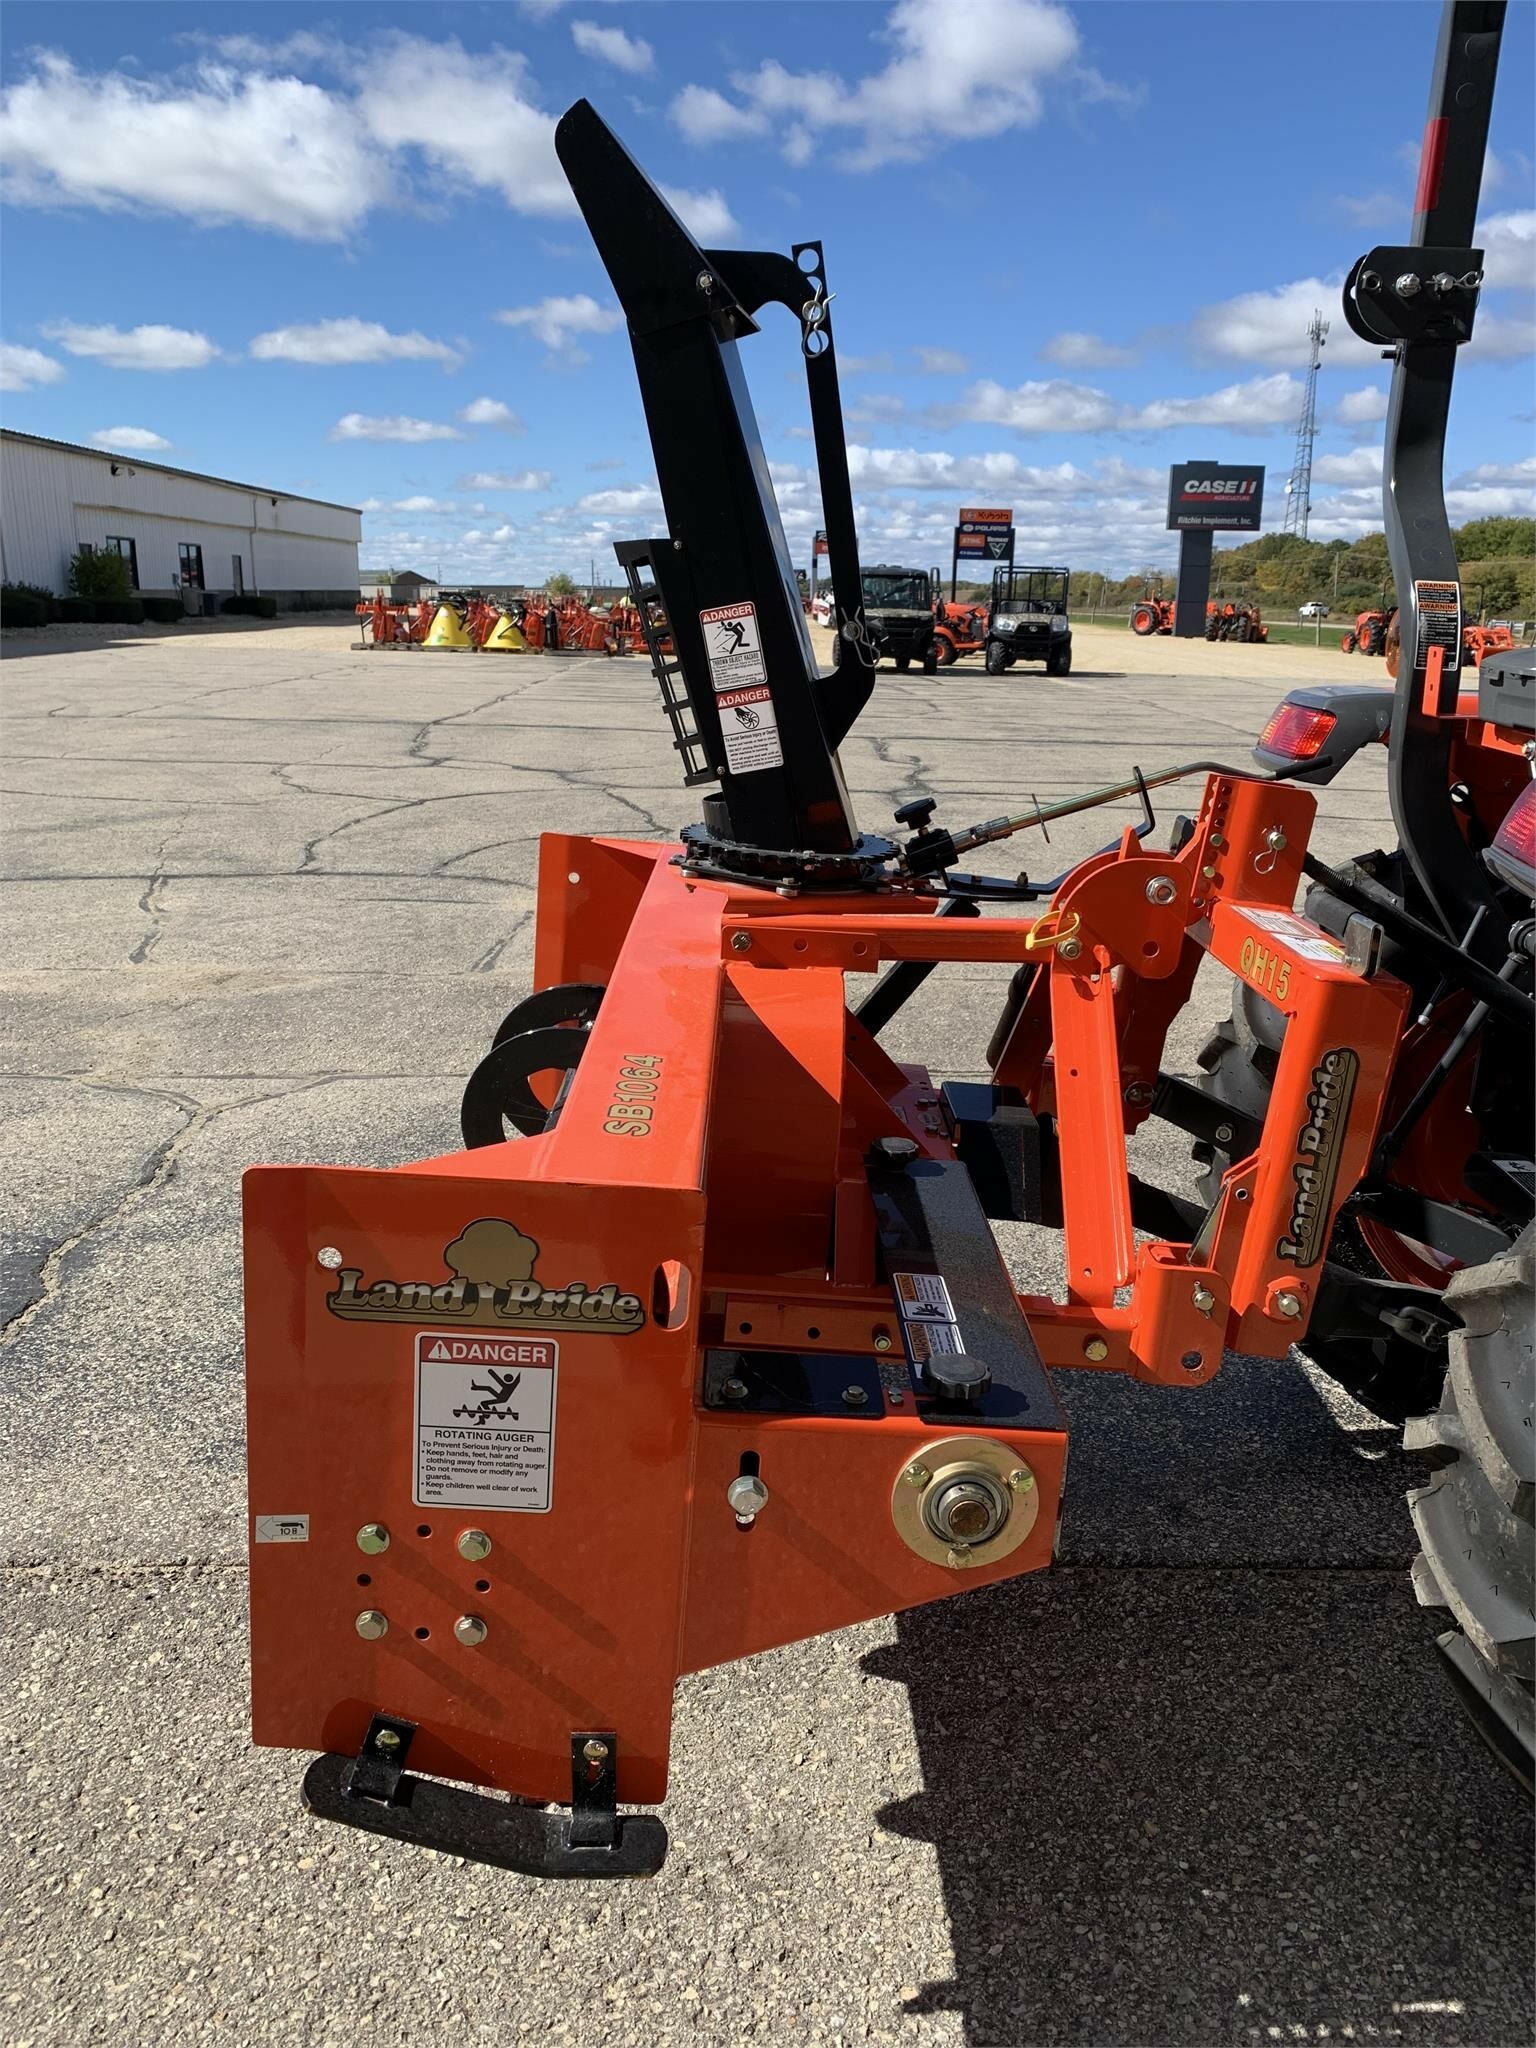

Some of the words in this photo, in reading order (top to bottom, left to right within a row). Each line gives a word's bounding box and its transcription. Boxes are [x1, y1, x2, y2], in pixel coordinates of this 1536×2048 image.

[1184, 480, 1238, 494] CASE
[978, 511, 1009, 520] Kubota
[1240, 517, 1254, 525] Inc.
[711, 605, 753, 621] DANGER
[727, 689, 771, 705] DANGER
[1241, 936, 1292, 1001] QH15
[603, 1055, 663, 1136] SB1064
[1299, 1053, 1347, 1157] Pride
[1278, 1163, 1325, 1262] Land
[334, 1269, 468, 1312] Land
[500, 1279, 644, 1322] Pride
[452, 1342, 547, 1363] DANGER
[435, 1430, 491, 1441] ROTATING
[495, 1433, 534, 1443] AUGER
[433, 1441, 460, 1449] Prevent
[462, 1442, 489, 1450] Serious
[491, 1444, 512, 1452] Injury
[426, 1449, 445, 1457] Keep
[446, 1450, 470, 1458] hands,
[472, 1451, 487, 1459] feet,
[426, 1457, 455, 1465] clothing
[457, 1459, 475, 1467] away
[496, 1460, 523, 1469] rotating
[525, 1462, 547, 1470] auger.
[489, 1468, 513, 1477] modify
[446, 1481, 474, 1490] children
[280, 1527, 291, 1536] 10
